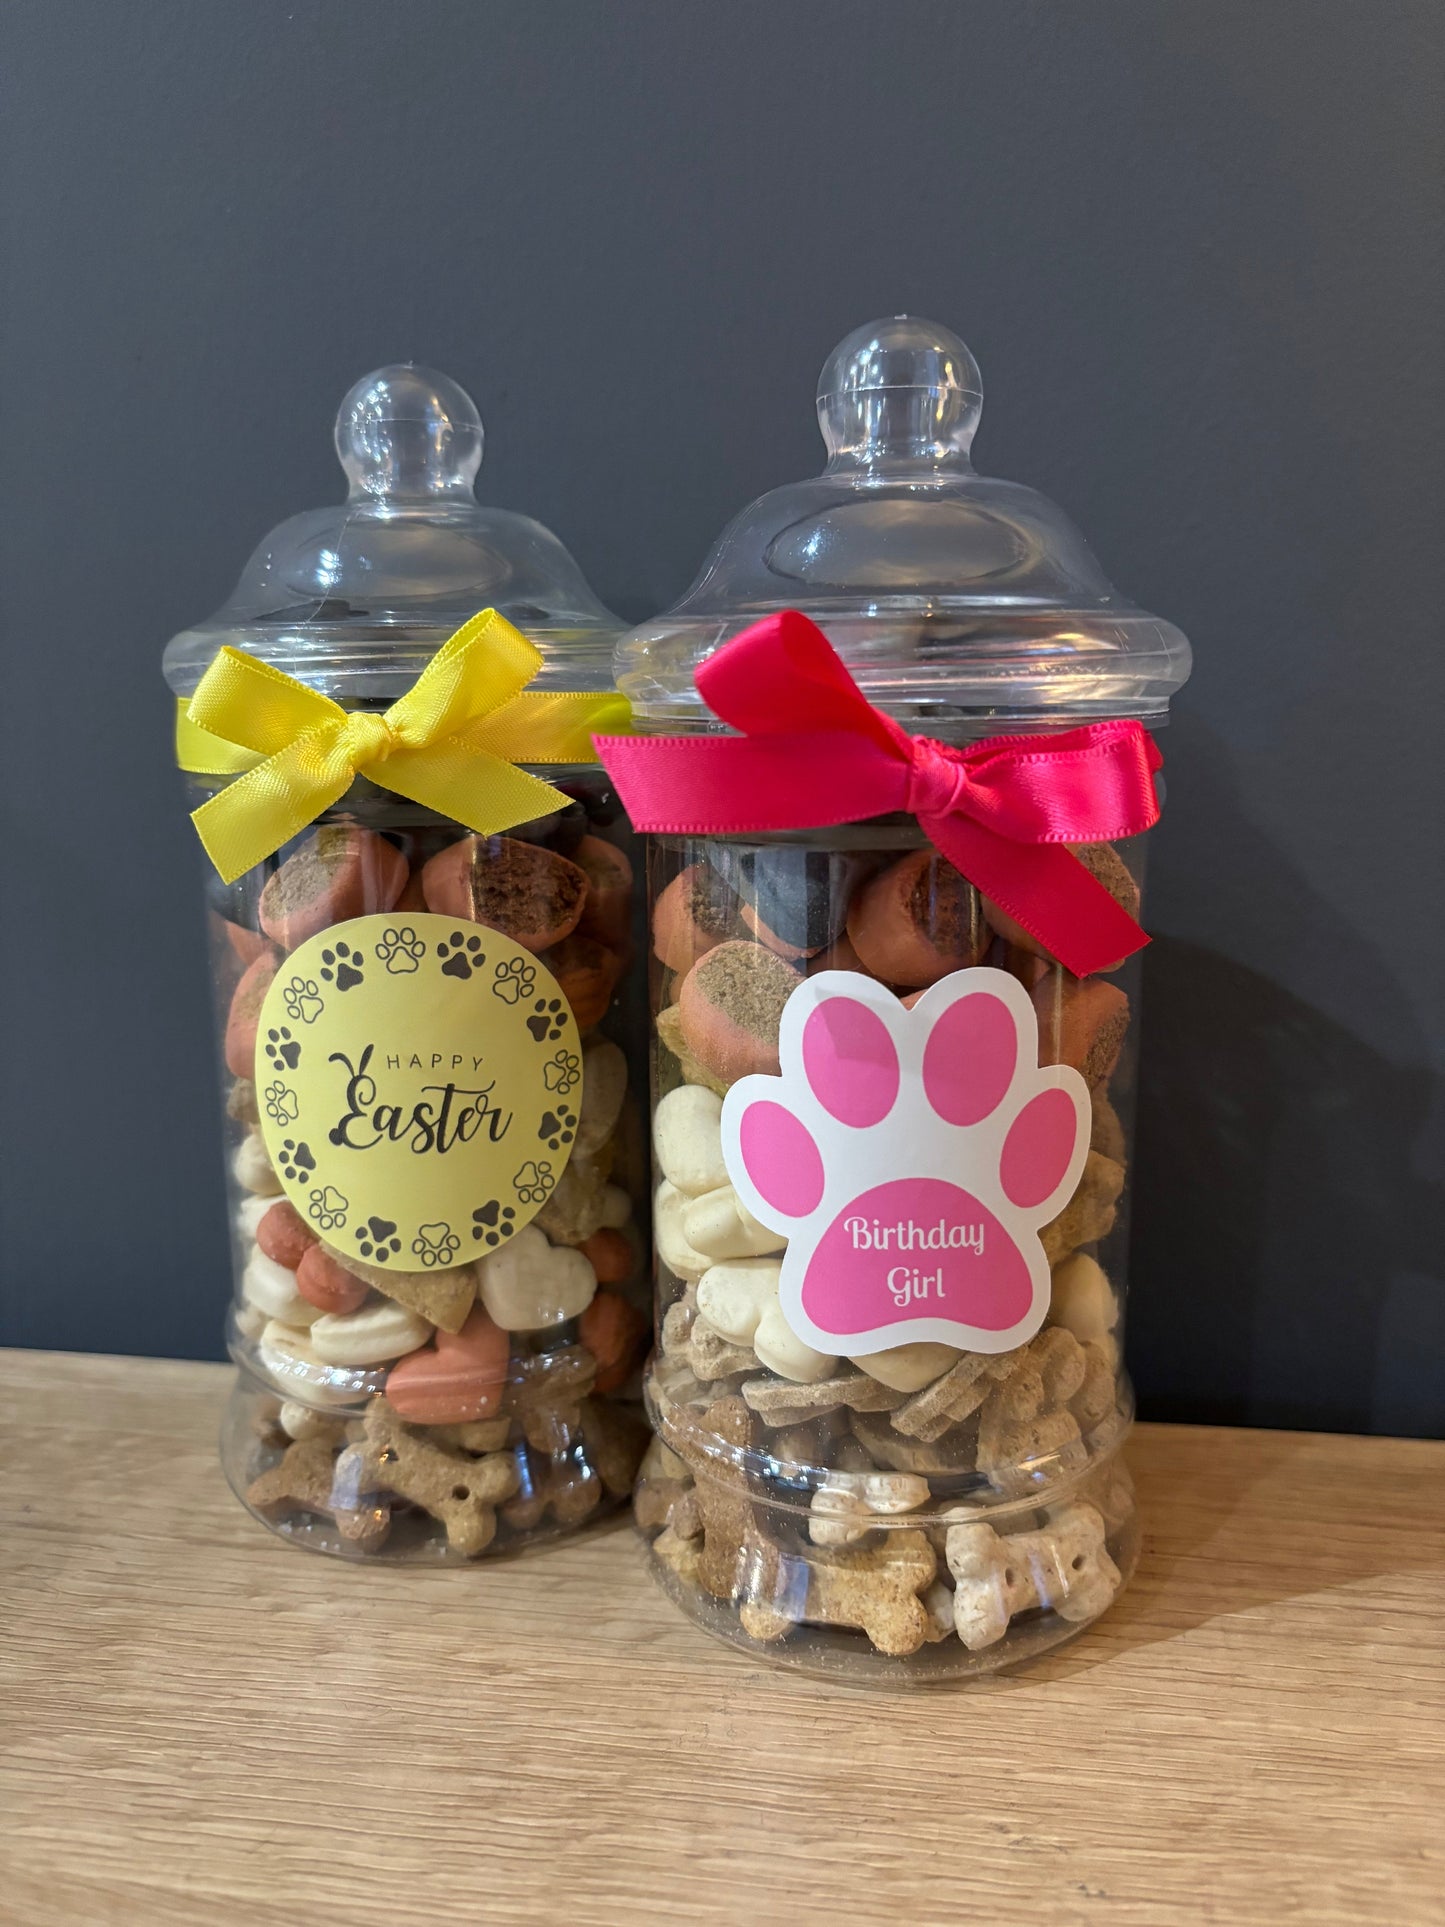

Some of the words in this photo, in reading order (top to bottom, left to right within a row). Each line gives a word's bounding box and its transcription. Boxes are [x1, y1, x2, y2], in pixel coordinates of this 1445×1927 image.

[387, 1053, 483, 1071] HAPPY
[328, 1073, 513, 1154] Easter
[843, 1216, 985, 1256] Birthday
[886, 1266, 946, 1307] Girl
